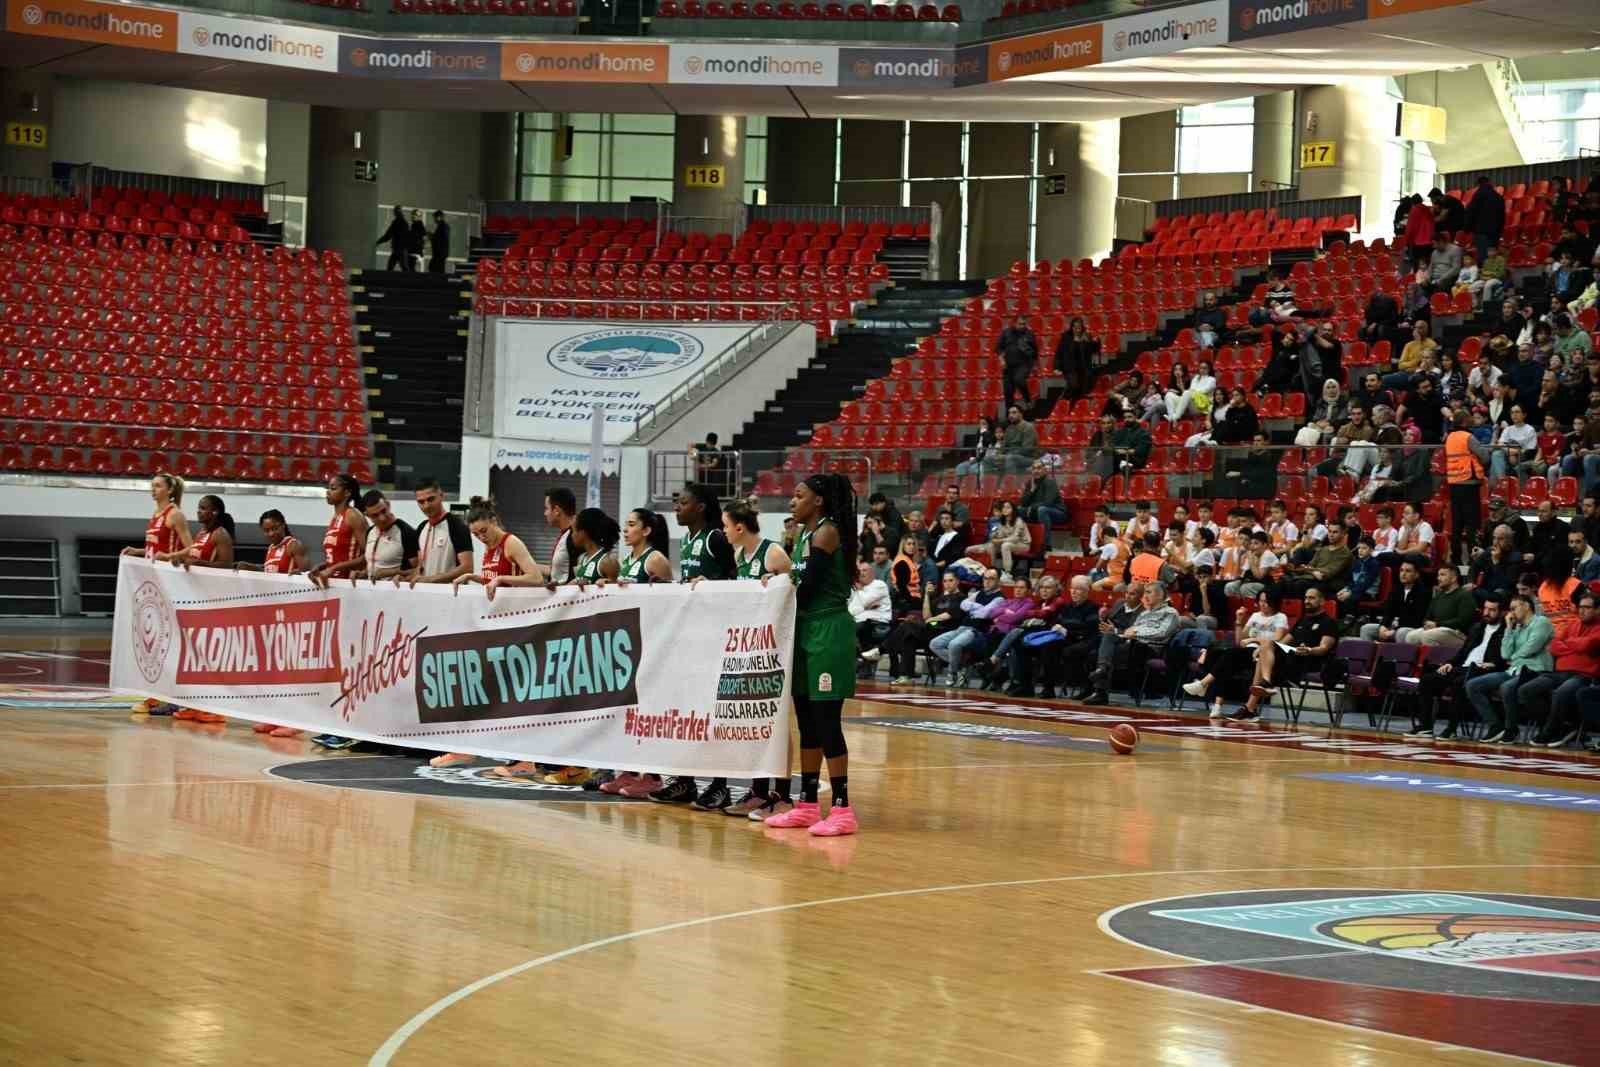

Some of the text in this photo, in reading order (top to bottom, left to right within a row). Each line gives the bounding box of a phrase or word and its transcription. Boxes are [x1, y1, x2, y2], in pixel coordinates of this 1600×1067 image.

[43, 9, 163, 39] mondihome
[1127, 17, 1217, 49] mondihome
[213, 32, 325, 60] mondihome
[1011, 39, 1093, 65] mondihome
[368, 50, 487, 70] mondihome
[535, 53, 655, 74] mondihome
[704, 56, 824, 76] mondihome
[12, 126, 43, 144] 119
[1304, 146, 1329, 163] 117
[689, 168, 720, 184] 118
[551, 388, 641, 399] KAYSERİ
[515, 409, 642, 423] BELEDİESİ
[262, 606, 336, 671] YÖNELİK
[725, 627, 739, 652] 25
[421, 628, 634, 710] SIFIR TOLERANS
[624, 707, 710, 745] #işaretiFarket
